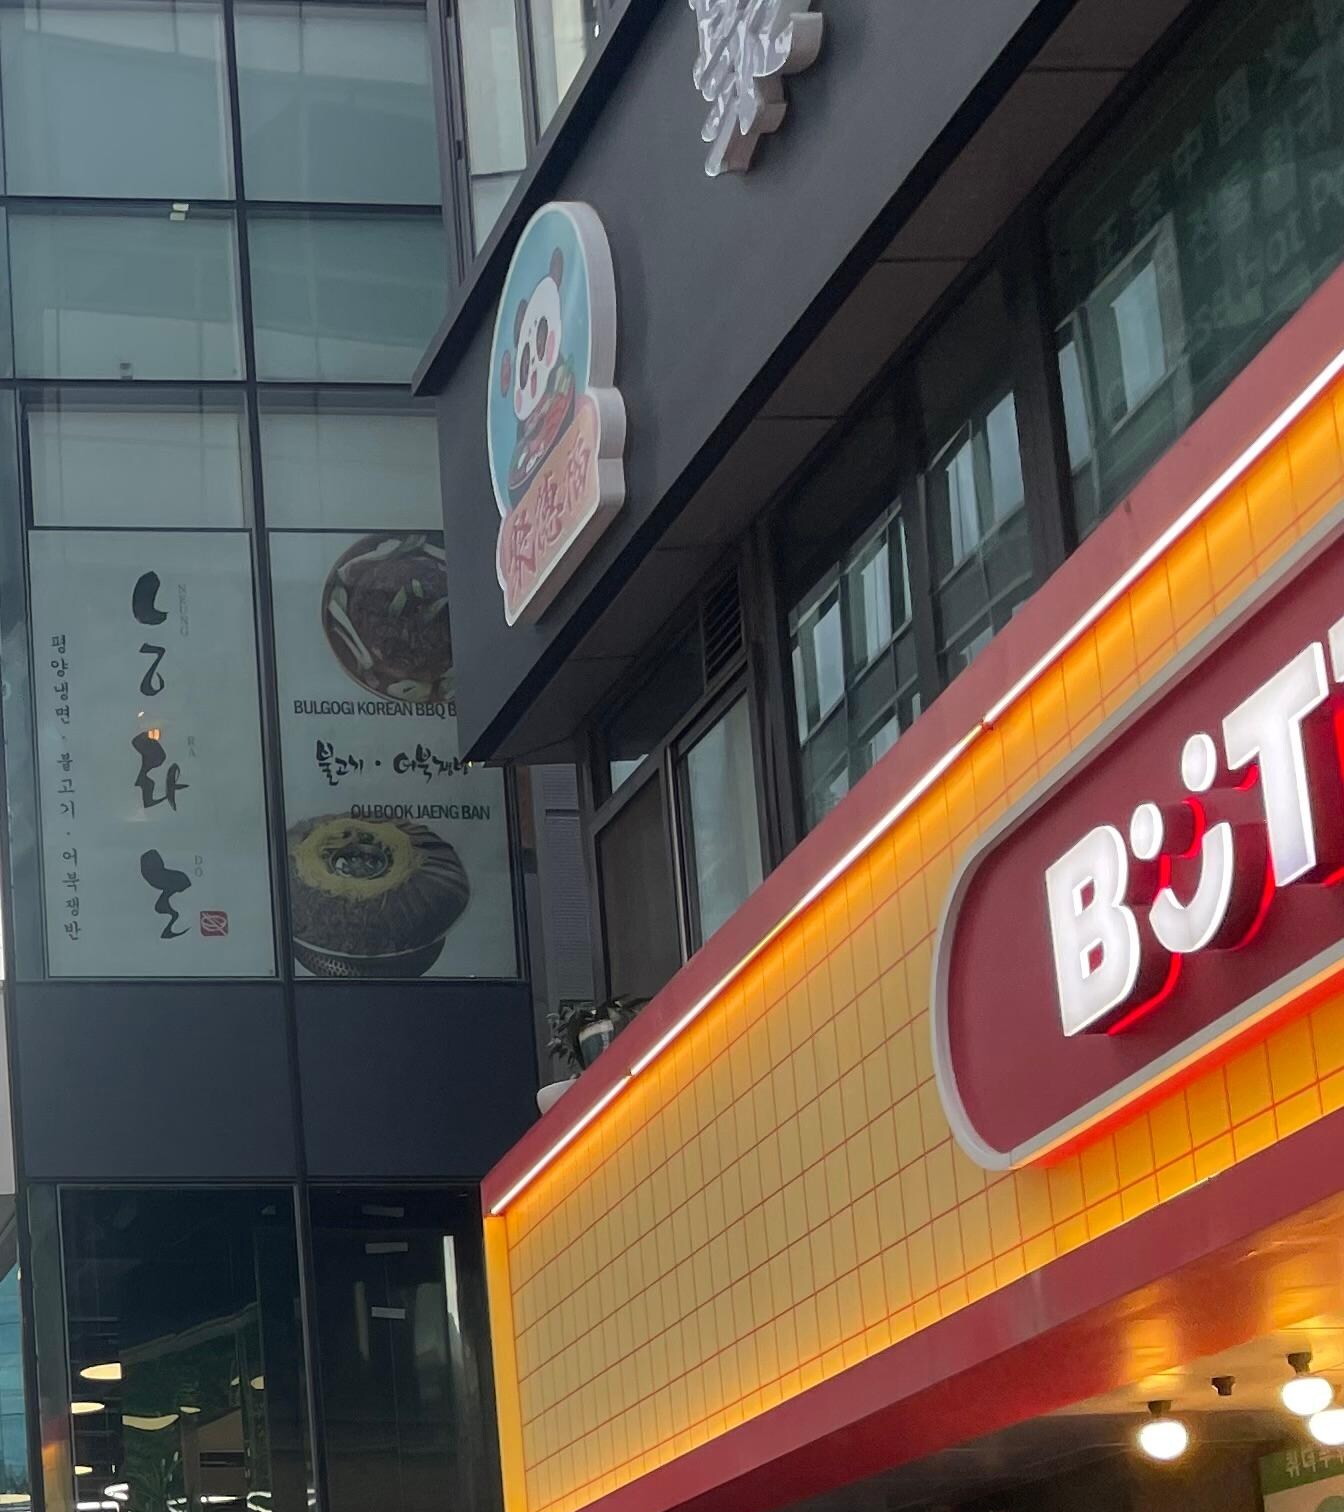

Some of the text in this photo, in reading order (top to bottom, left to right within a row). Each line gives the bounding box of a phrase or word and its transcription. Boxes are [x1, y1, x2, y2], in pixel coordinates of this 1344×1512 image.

[294, 700, 355, 714] BULGOGI
[358, 701, 413, 716] KOREAN
[416, 702, 445, 719] BBQ
[462, 805, 490, 820] BAN
